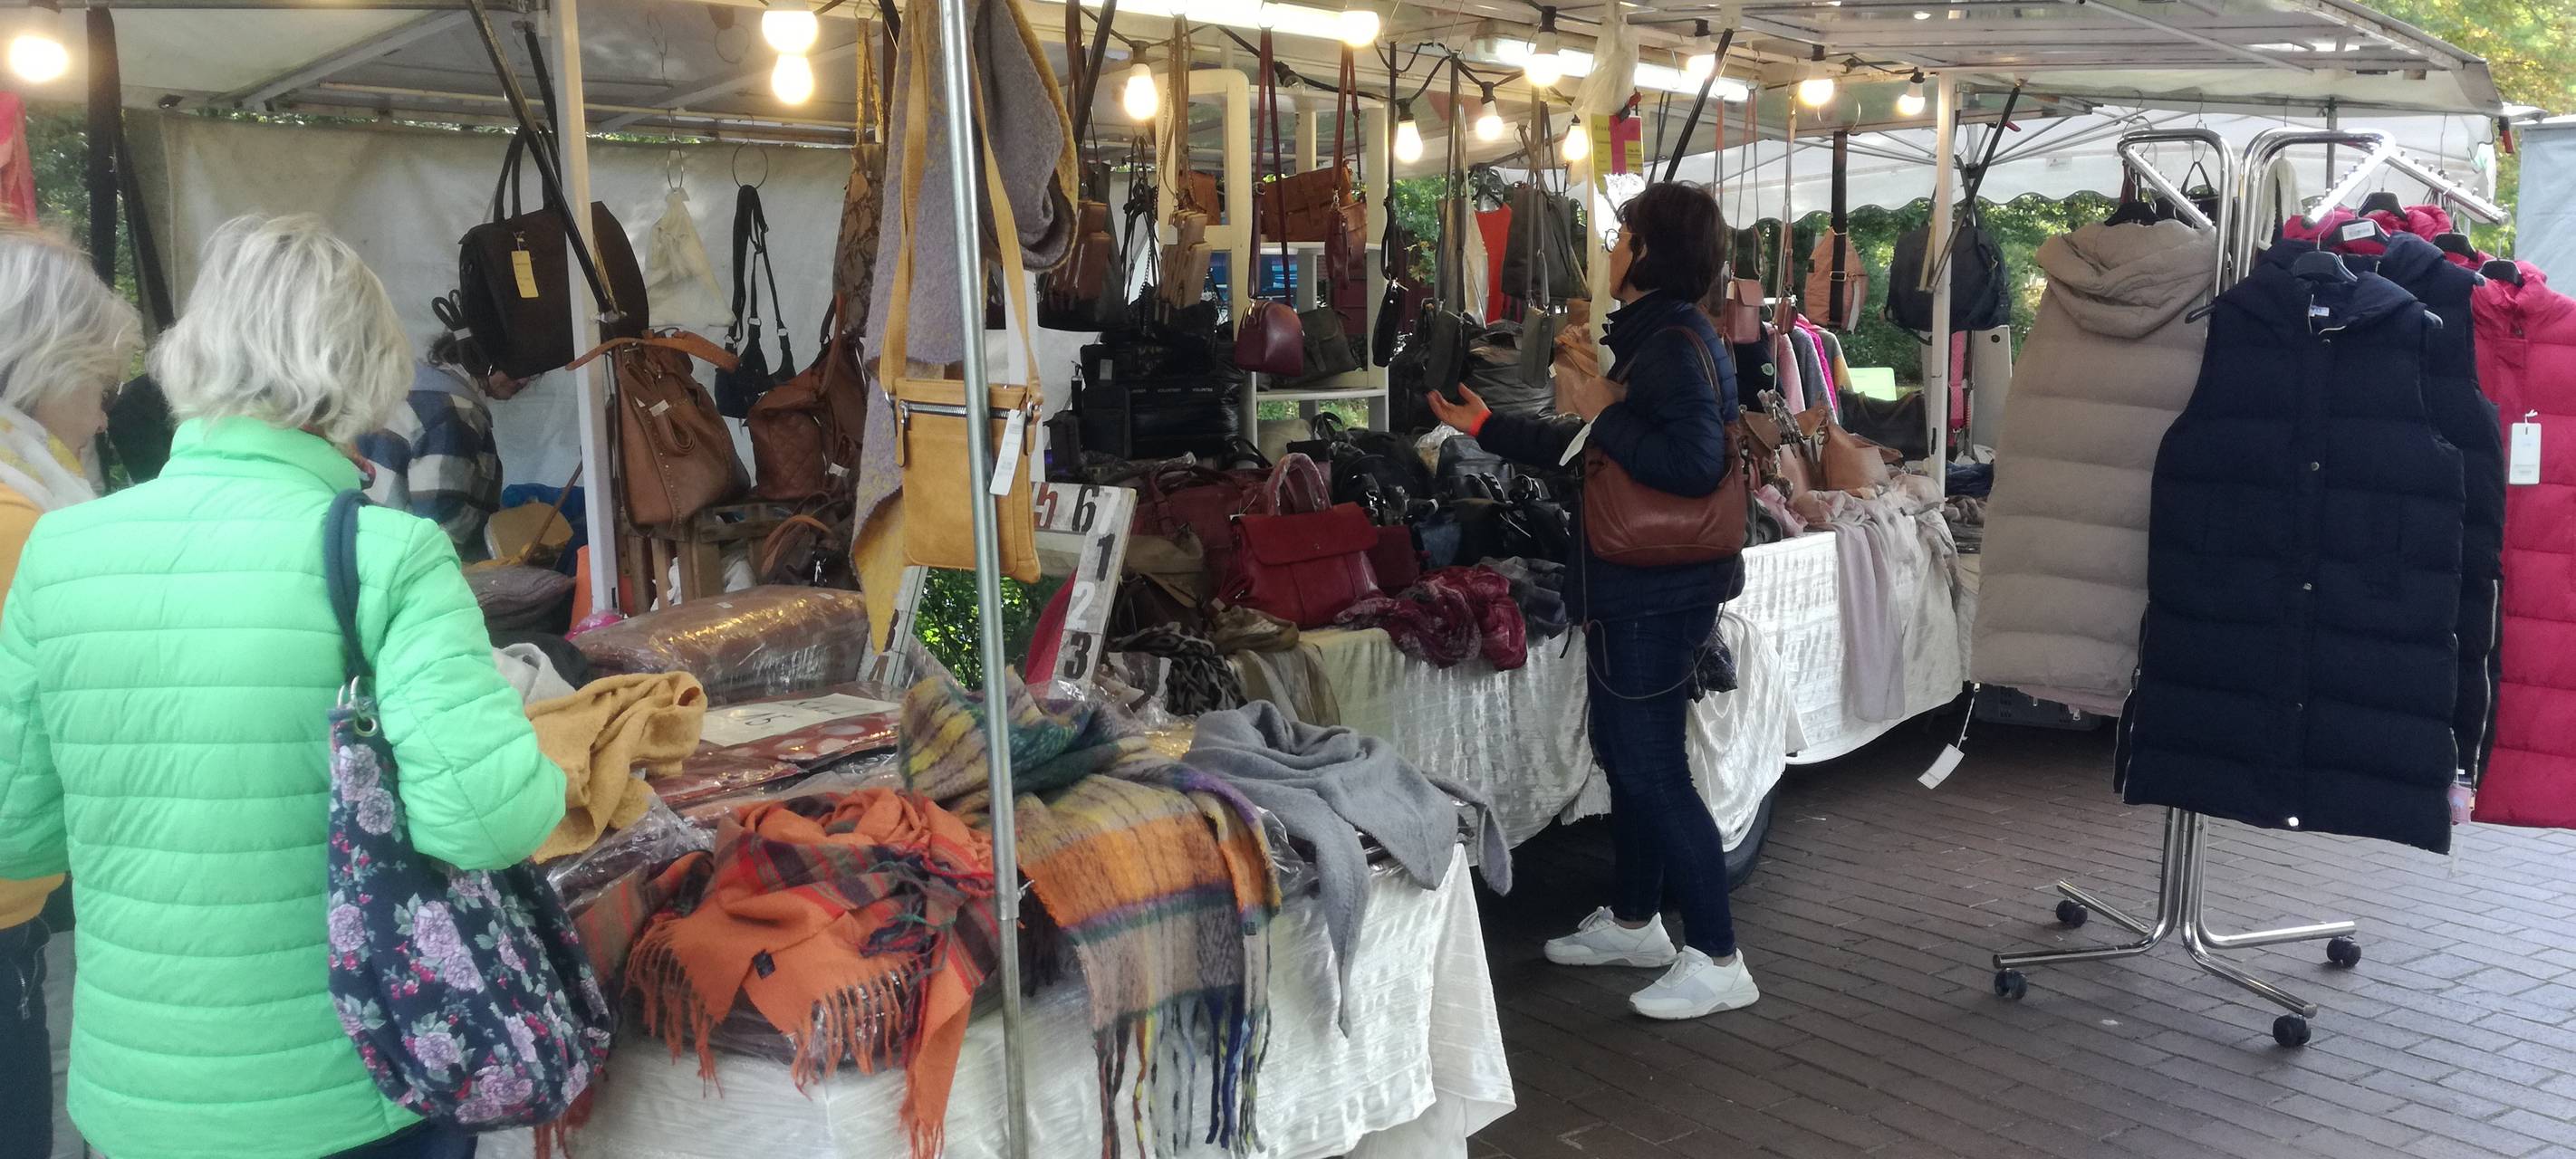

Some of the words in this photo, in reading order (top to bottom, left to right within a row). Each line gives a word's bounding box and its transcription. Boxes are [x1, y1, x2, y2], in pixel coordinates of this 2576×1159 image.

[1033, 483, 1058, 529] 5
[1072, 484, 1100, 532] 6
[1096, 532, 1115, 581] 1
[1065, 581, 1095, 629] 2
[1063, 632, 1092, 680] 3
